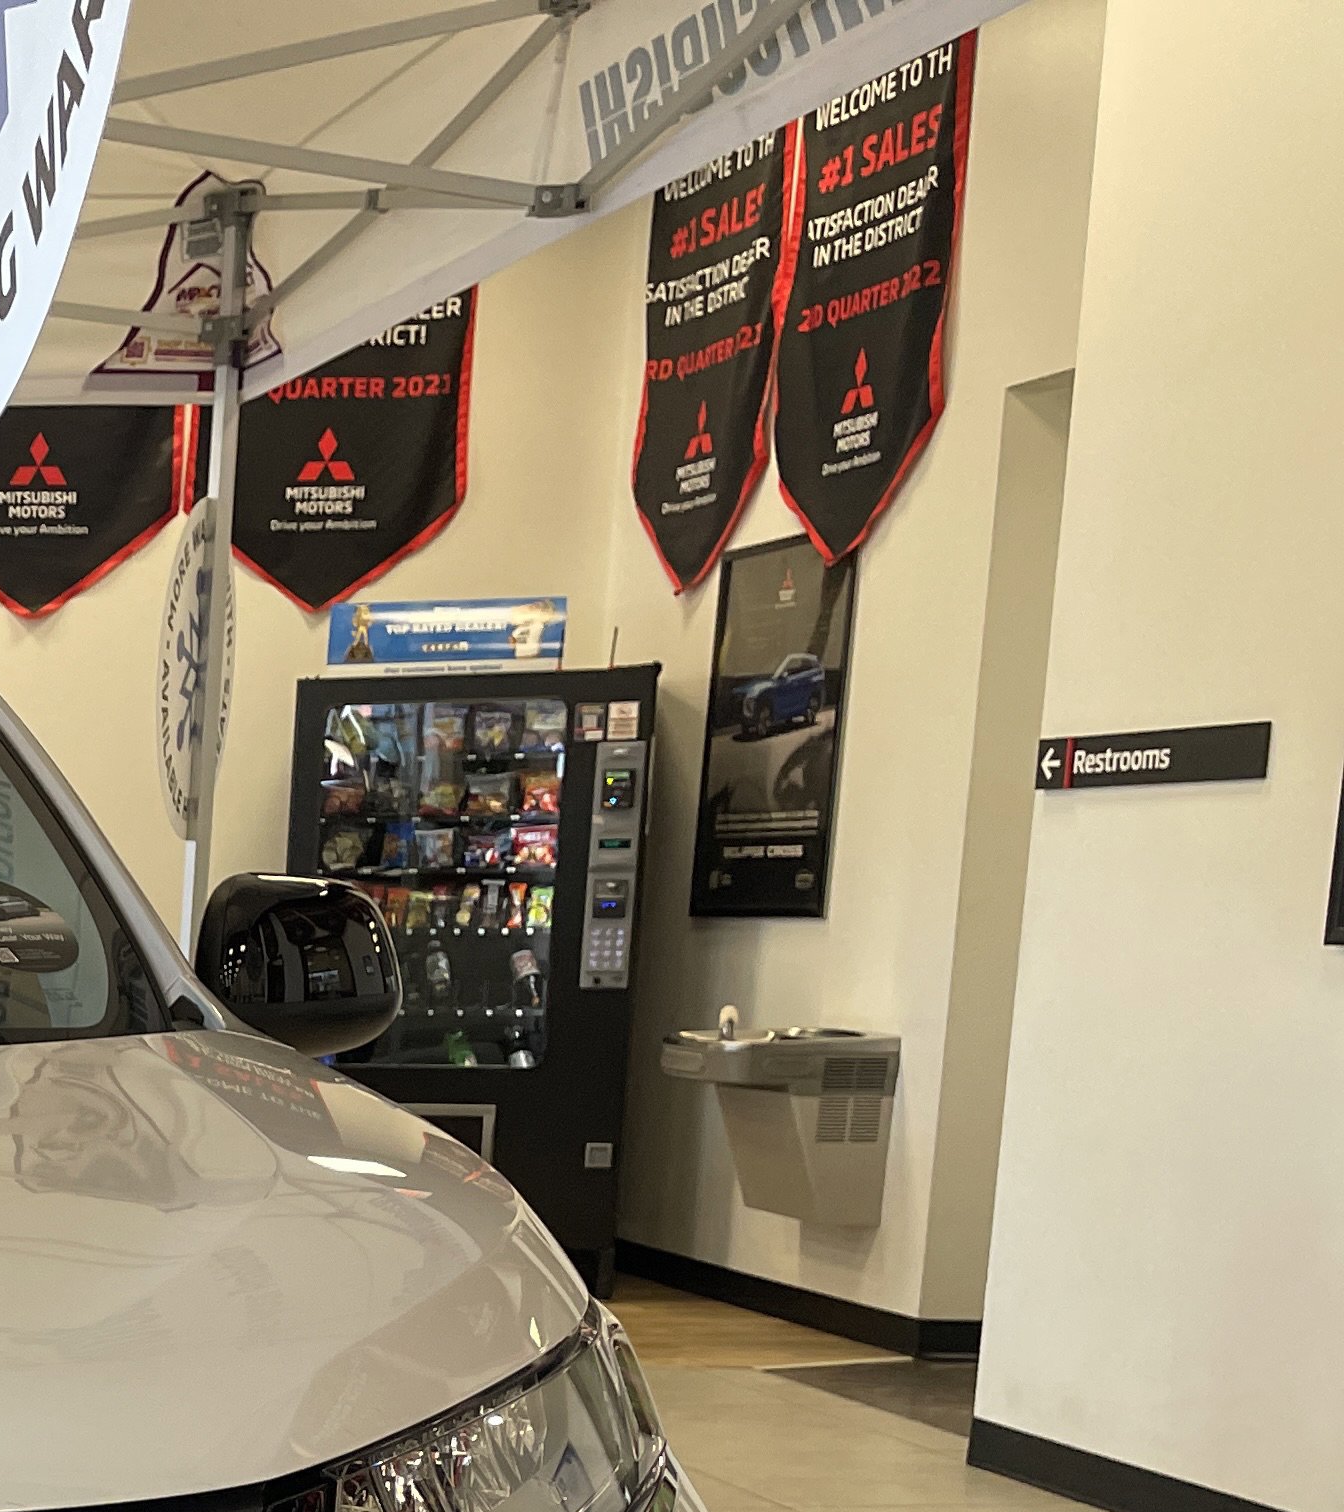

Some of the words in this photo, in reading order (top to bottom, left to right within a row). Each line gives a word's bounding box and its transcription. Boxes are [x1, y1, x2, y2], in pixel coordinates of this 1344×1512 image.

[815, 71, 897, 132] WELCOME
[899, 59, 923, 92] TO
[927, 43, 954, 79] TH
[22, 0, 107, 247] WAR
[758, 132, 776, 160] TH
[818, 144, 854, 194] #1
[860, 103, 944, 177] SALES
[808, 190, 895, 240] ATISFACTION
[670, 216, 697, 259] #1
[813, 245, 831, 268] IN
[832, 235, 862, 264] THE
[664, 304, 682, 327] IN
[826, 276, 899, 328] QUARTER
[368, 324, 427, 346] RICT!
[646, 357, 673, 382] RD
[267, 376, 385, 404] QUARTER
[391, 373, 451, 398] 2021
[285, 485, 365, 500] MITSUBISHI
[8, 505, 66, 520] MOTORS
[295, 501, 353, 515] MOTORS
[13, 525, 38, 537] your
[39, 523, 89, 535] Ambition
[1073, 746, 1170, 775] Restrooms
